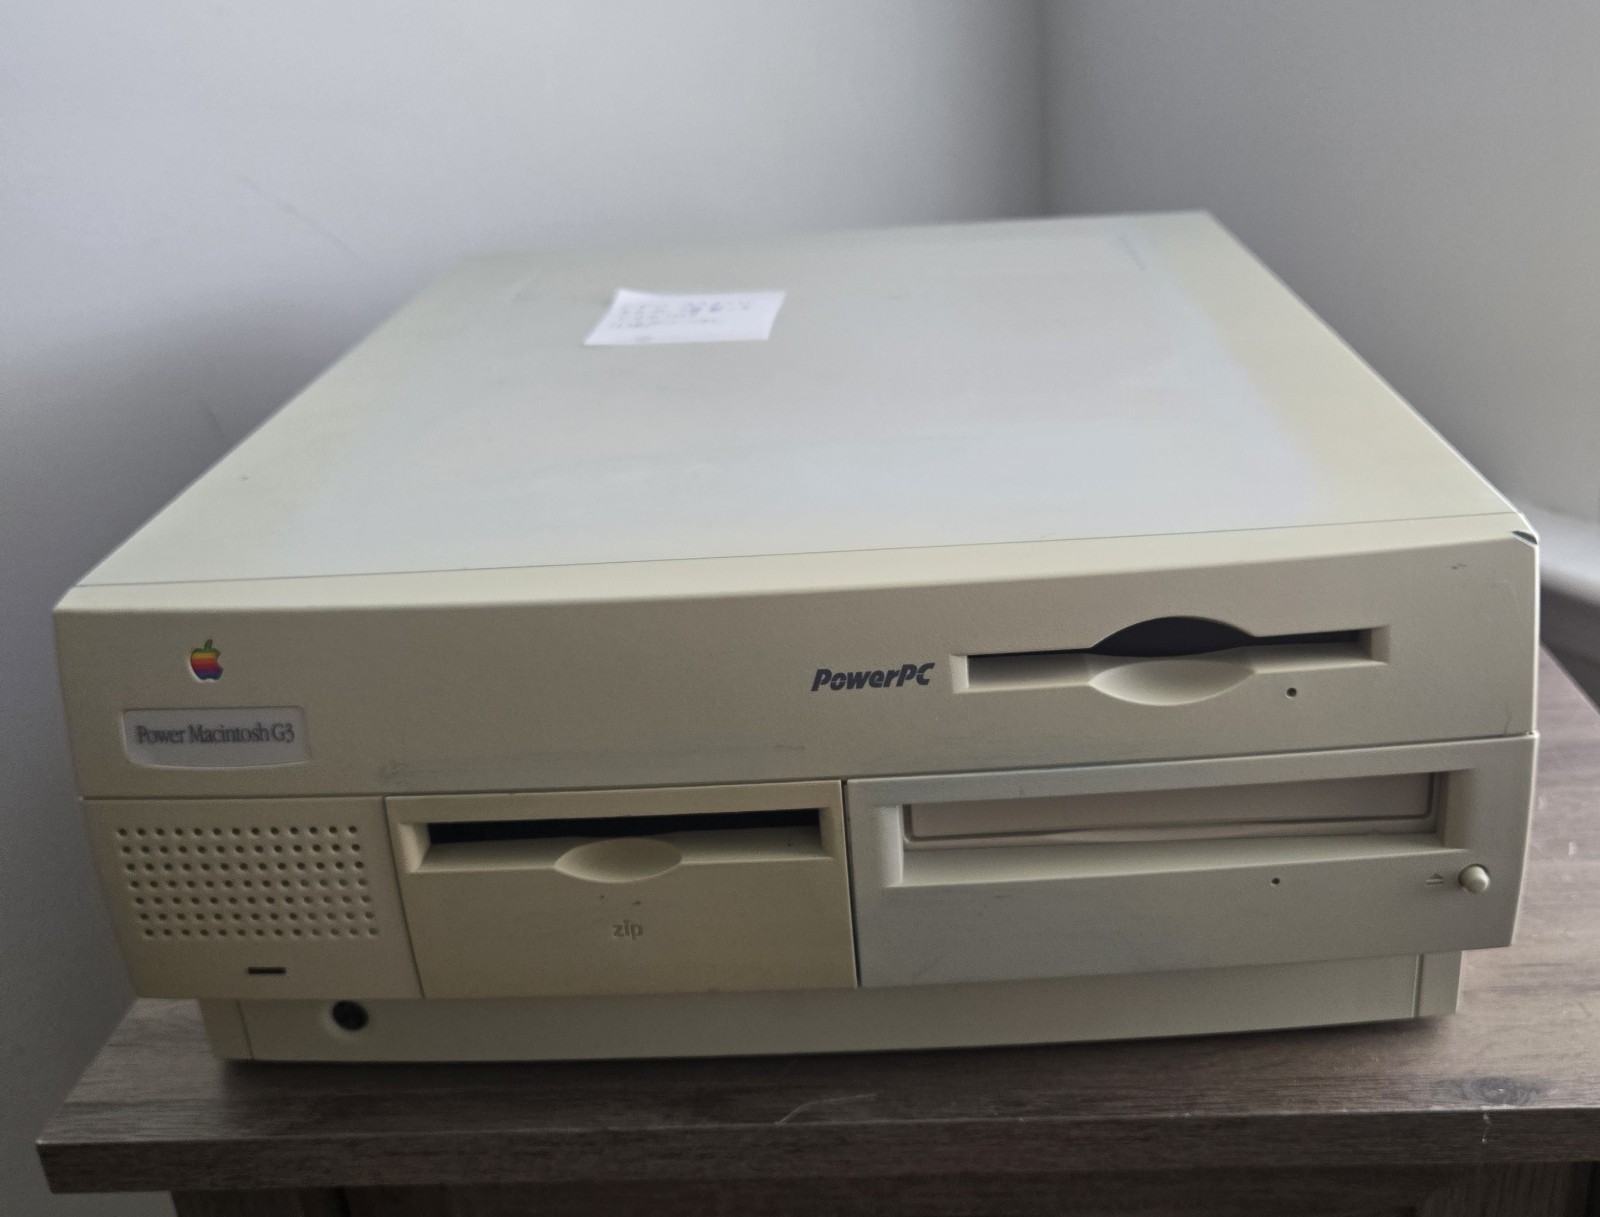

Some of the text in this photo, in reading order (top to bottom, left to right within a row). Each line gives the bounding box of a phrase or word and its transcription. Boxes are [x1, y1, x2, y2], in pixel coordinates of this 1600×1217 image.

[810, 662, 936, 692] PowerPC
[135, 722, 295, 744] Power Macintosh G3
[612, 919, 644, 940] zip
